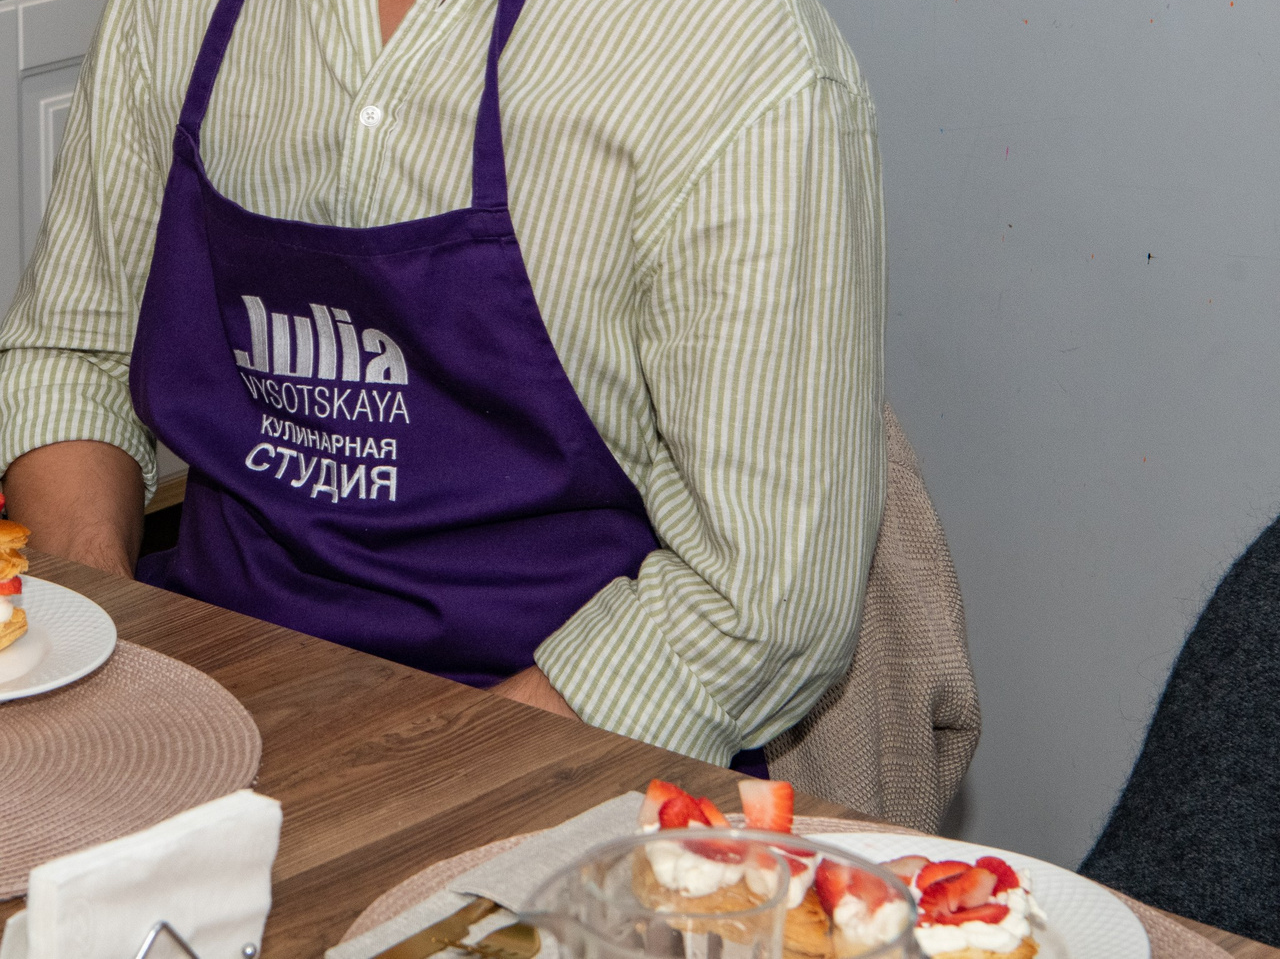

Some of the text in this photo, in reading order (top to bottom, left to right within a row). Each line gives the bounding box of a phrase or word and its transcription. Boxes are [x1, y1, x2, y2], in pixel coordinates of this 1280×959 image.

[233, 295, 409, 385] Julia
[240, 372, 410, 424] VYSOTSKAYA
[260, 414, 397, 460] КУЛИНАРНАЯ
[245, 443, 398, 504] СТУДИЯ
